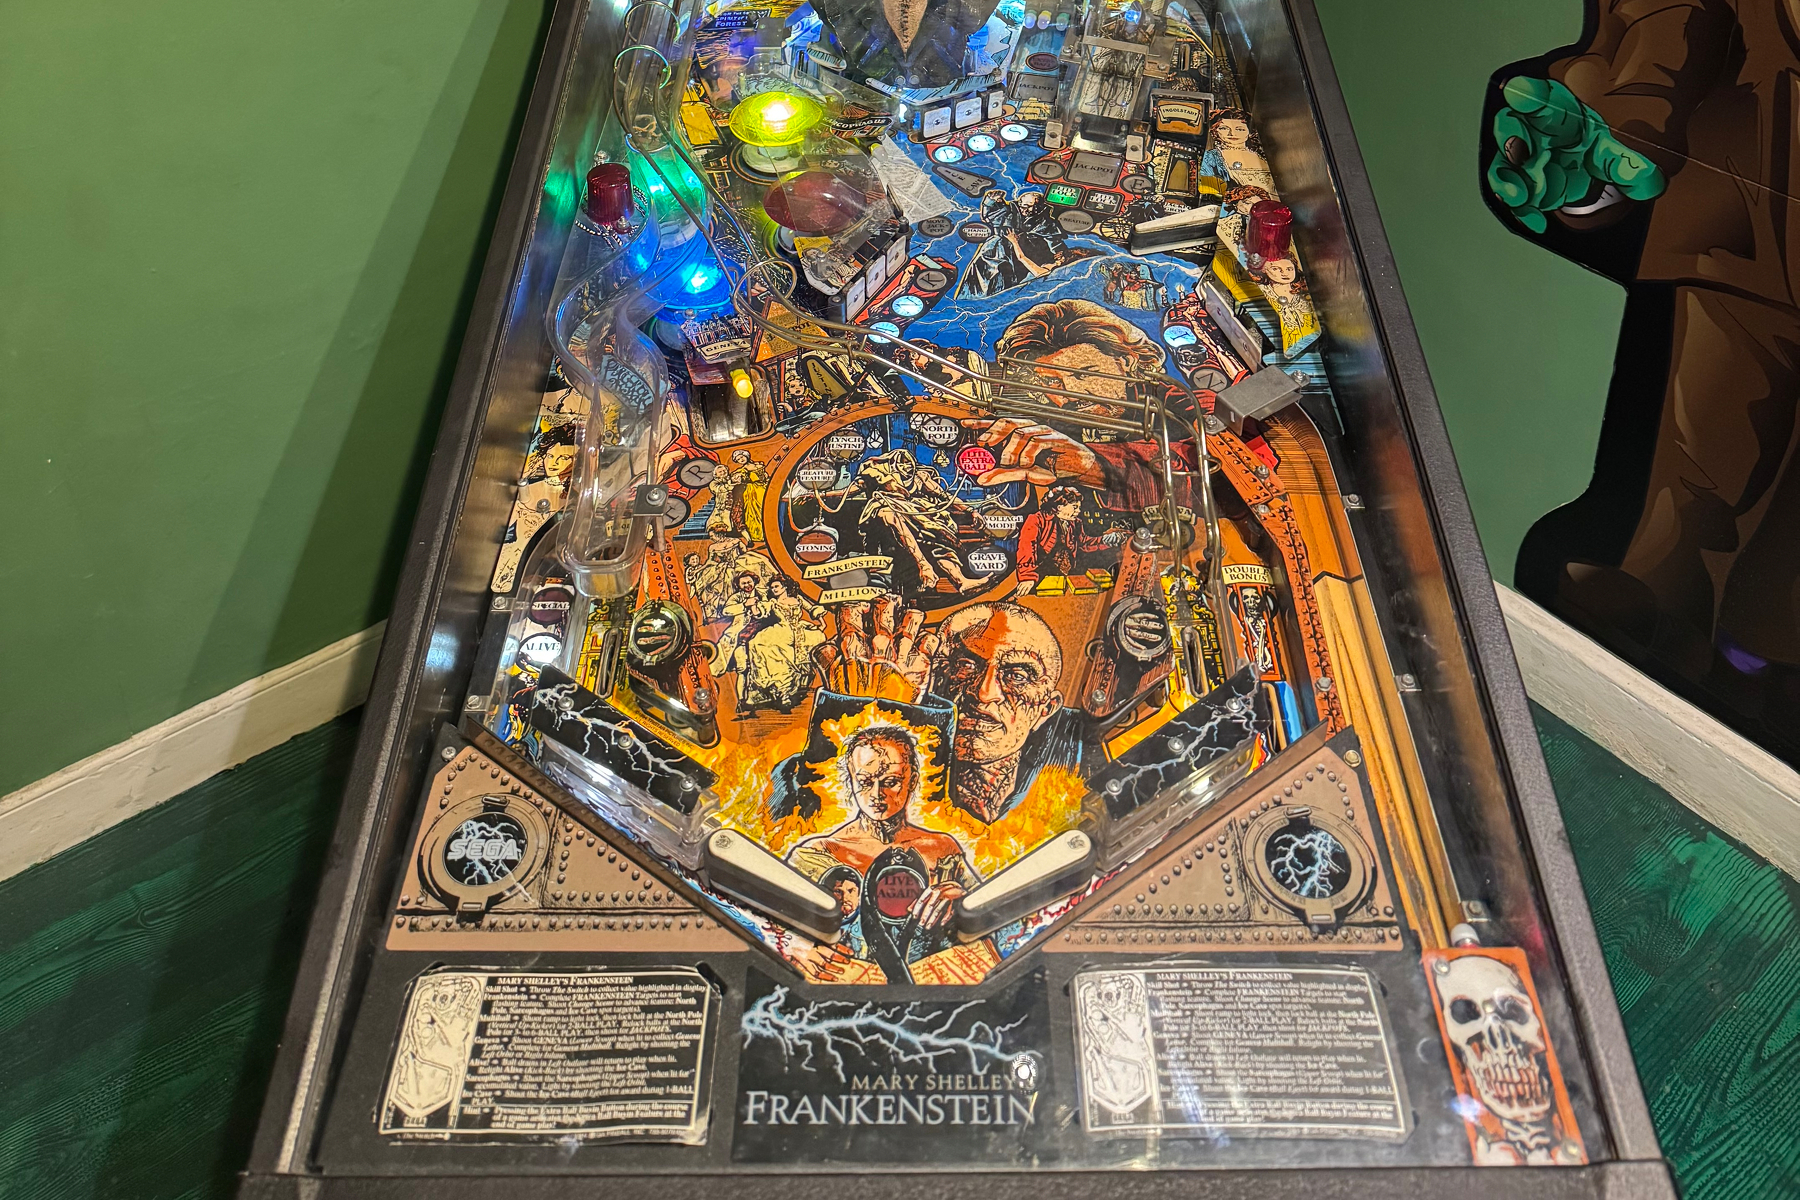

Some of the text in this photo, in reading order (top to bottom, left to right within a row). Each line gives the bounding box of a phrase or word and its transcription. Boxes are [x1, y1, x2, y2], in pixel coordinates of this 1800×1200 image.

[1019, 83, 1055, 92] JACKPOT
[1041, 163, 1058, 176] T
[1073, 162, 1115, 174] JACKPOT
[965, 177, 986, 191] CAVE
[1130, 178, 1146, 192] E
[705, 340, 748, 352] GENEVA
[1198, 375, 1225, 391] N
[923, 425, 958, 433] NORTH
[686, 464, 708, 482] R
[969, 552, 1006, 561] GRAVE
[807, 558, 891, 577] FRANKENSTEIN
[975, 561, 1006, 571] YARD
[1224, 566, 1269, 576] DOUBLE
[1229, 573, 1268, 583] BONUS
[823, 587, 884, 600] MILLIONS
[531, 601, 571, 610] SPECIAL
[523, 641, 561, 652] ALIVE
[884, 876, 914, 886] LIVE
[877, 888, 921, 899] AGAIN
[497, 975, 634, 985] MARY SHELLEY'S FRANKENSTEIN
[1229, 971, 1293, 981] FRANKENSTEIN
[530, 985, 552, 993] Throw
[638, 983, 675, 993] highlighted
[682, 983, 706, 993] display
[572, 992, 634, 1000] FRANKENSTEIN
[635, 992, 660, 1000] Targets
[851, 1074, 918, 1090] MARY
[743, 1091, 1036, 1125] FRANKENSTEIN
